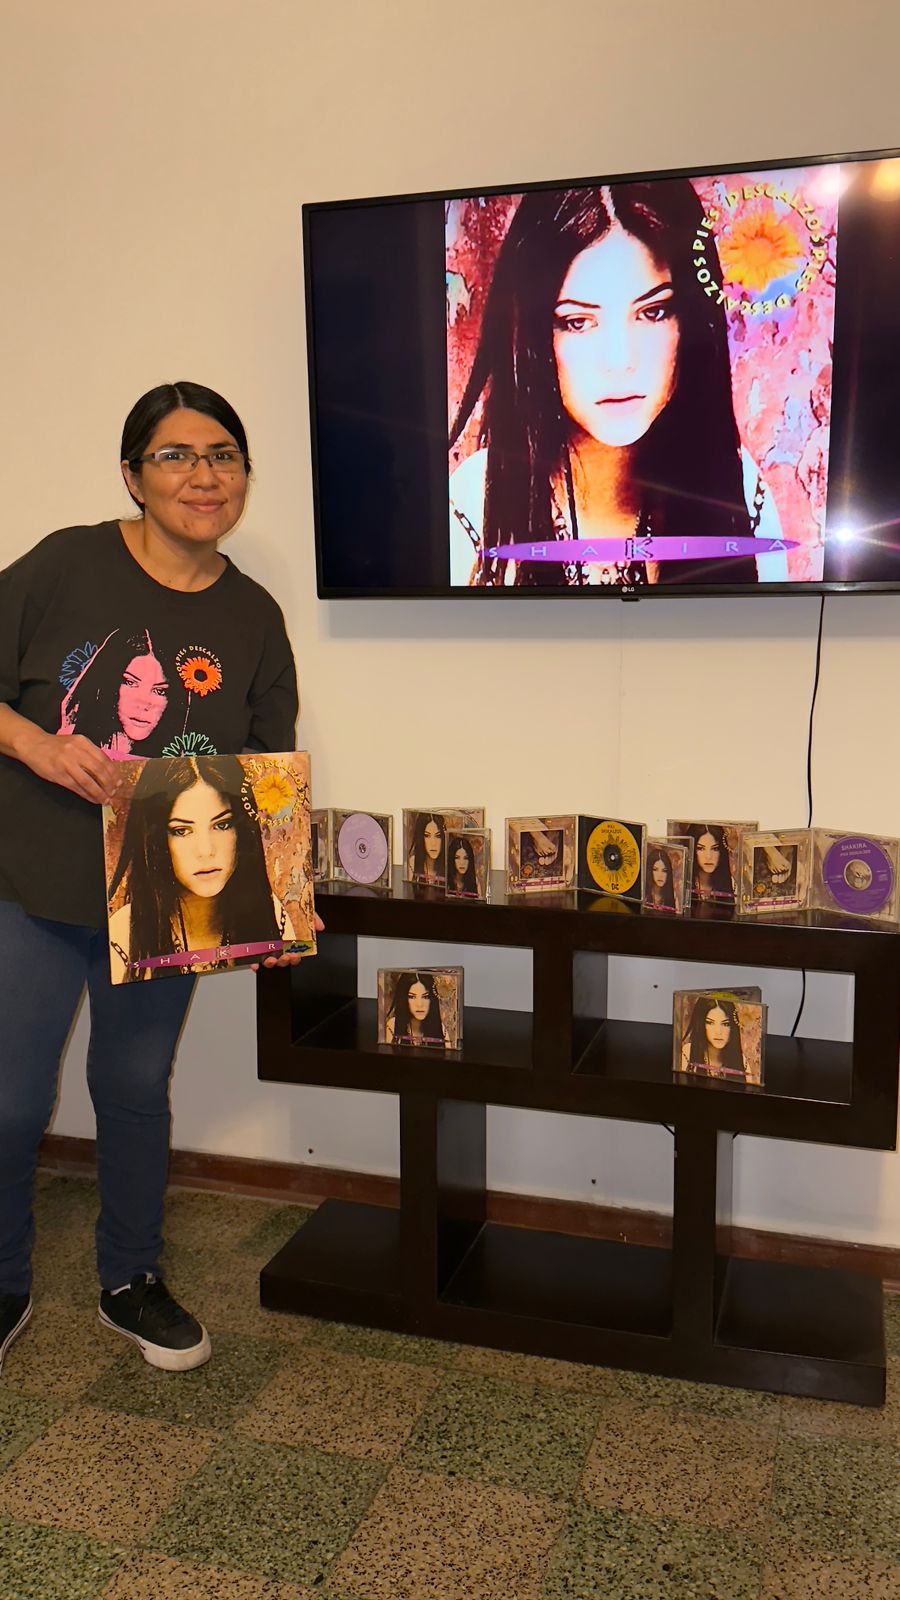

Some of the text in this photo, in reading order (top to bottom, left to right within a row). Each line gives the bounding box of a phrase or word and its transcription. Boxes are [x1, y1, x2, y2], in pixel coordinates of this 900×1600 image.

[693, 207, 720, 251] PIES
[488, 538, 788, 558] SHAKIRA
[175, 648, 187, 661] PIES
[241, 772, 254, 794] PIES
